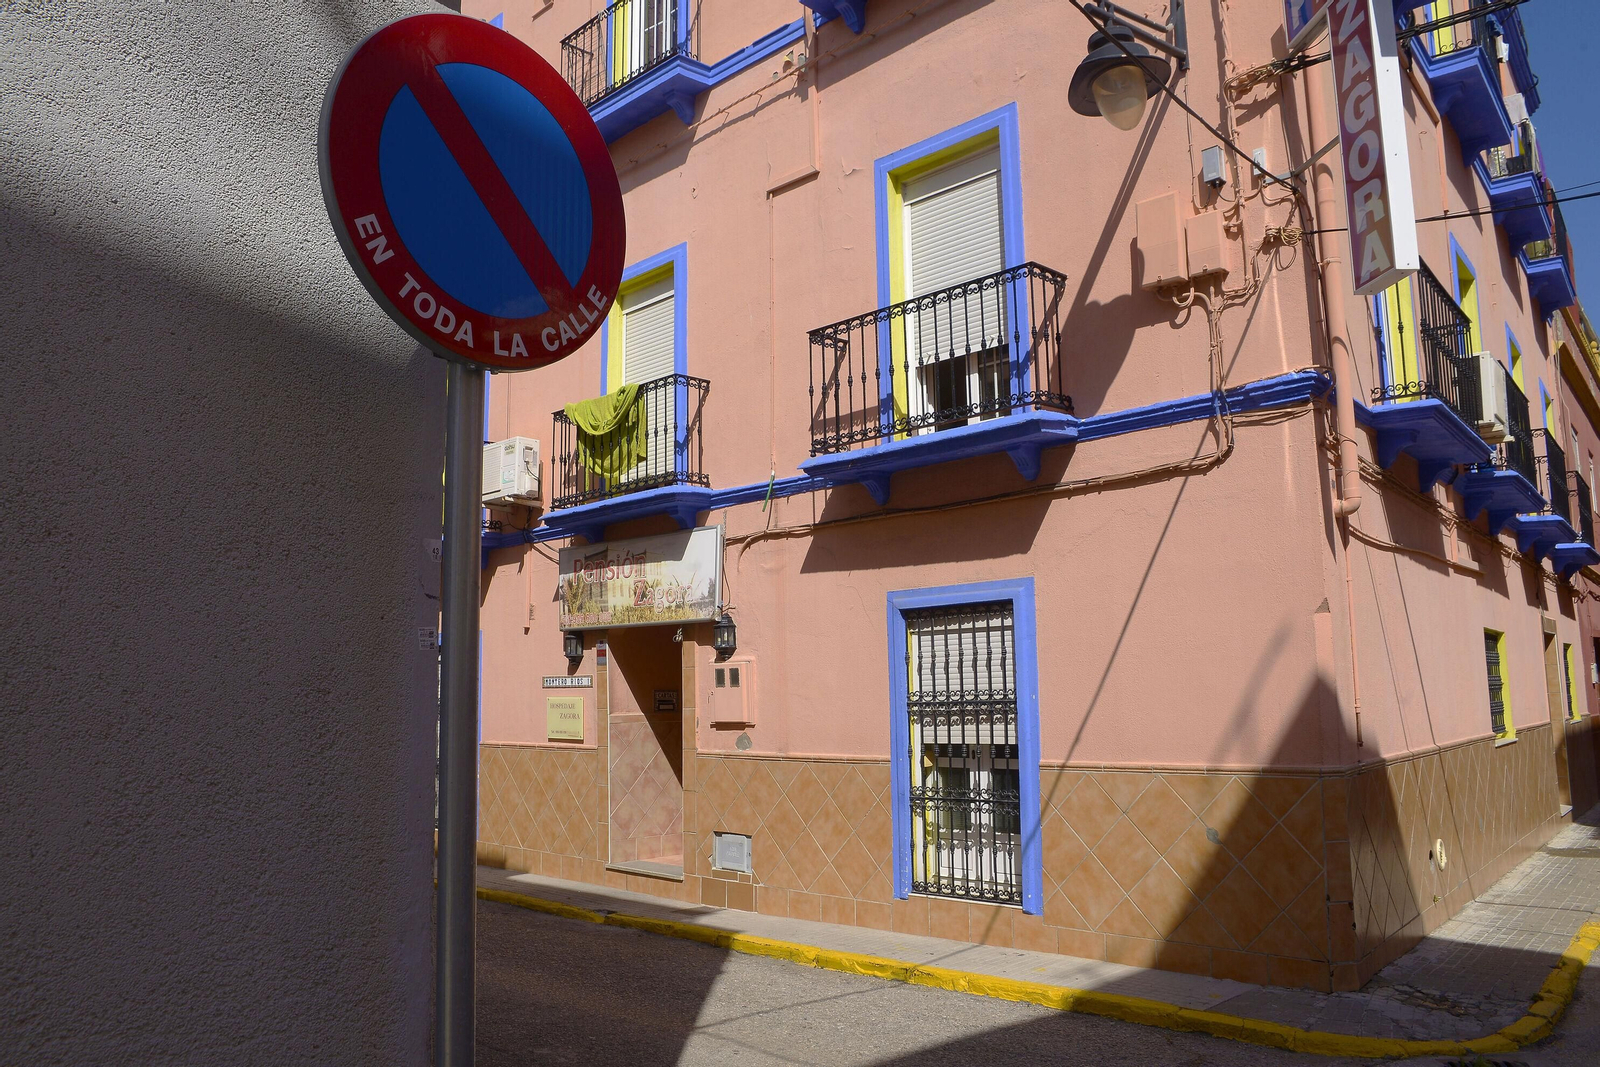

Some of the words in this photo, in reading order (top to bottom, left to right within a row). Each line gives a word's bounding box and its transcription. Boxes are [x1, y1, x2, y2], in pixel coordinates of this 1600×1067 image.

[1336, 0, 1391, 285] ZAGORA
[354, 213, 395, 265] EN
[398, 272, 474, 348] TODA
[494, 330, 528, 357] LA
[541, 284, 608, 352] CALLE
[573, 550, 646, 585] Pensión
[633, 578, 694, 614] Zagora
[550, 702, 575, 710] HOSPEDAJE
[559, 712, 581, 720] ZAGORA
